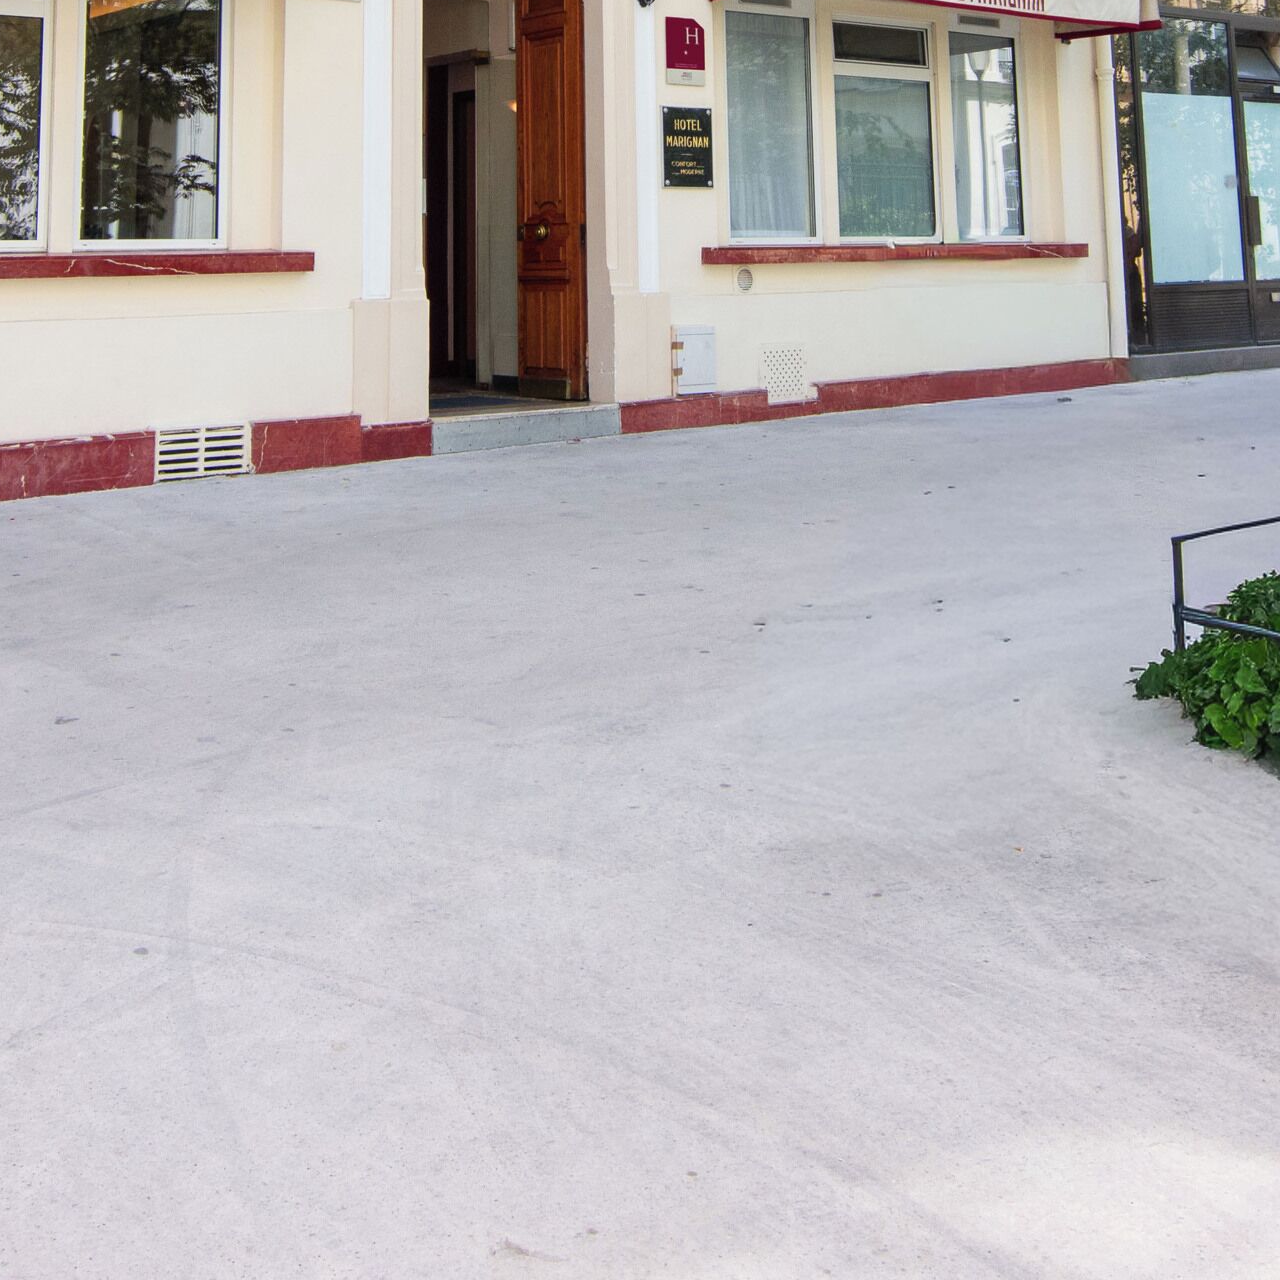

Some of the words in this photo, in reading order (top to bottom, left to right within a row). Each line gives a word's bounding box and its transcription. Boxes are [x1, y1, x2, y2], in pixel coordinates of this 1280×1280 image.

[685, 27, 699, 45] H
[674, 119, 702, 131] HOTEL
[666, 135, 709, 148] MARIGNAN
